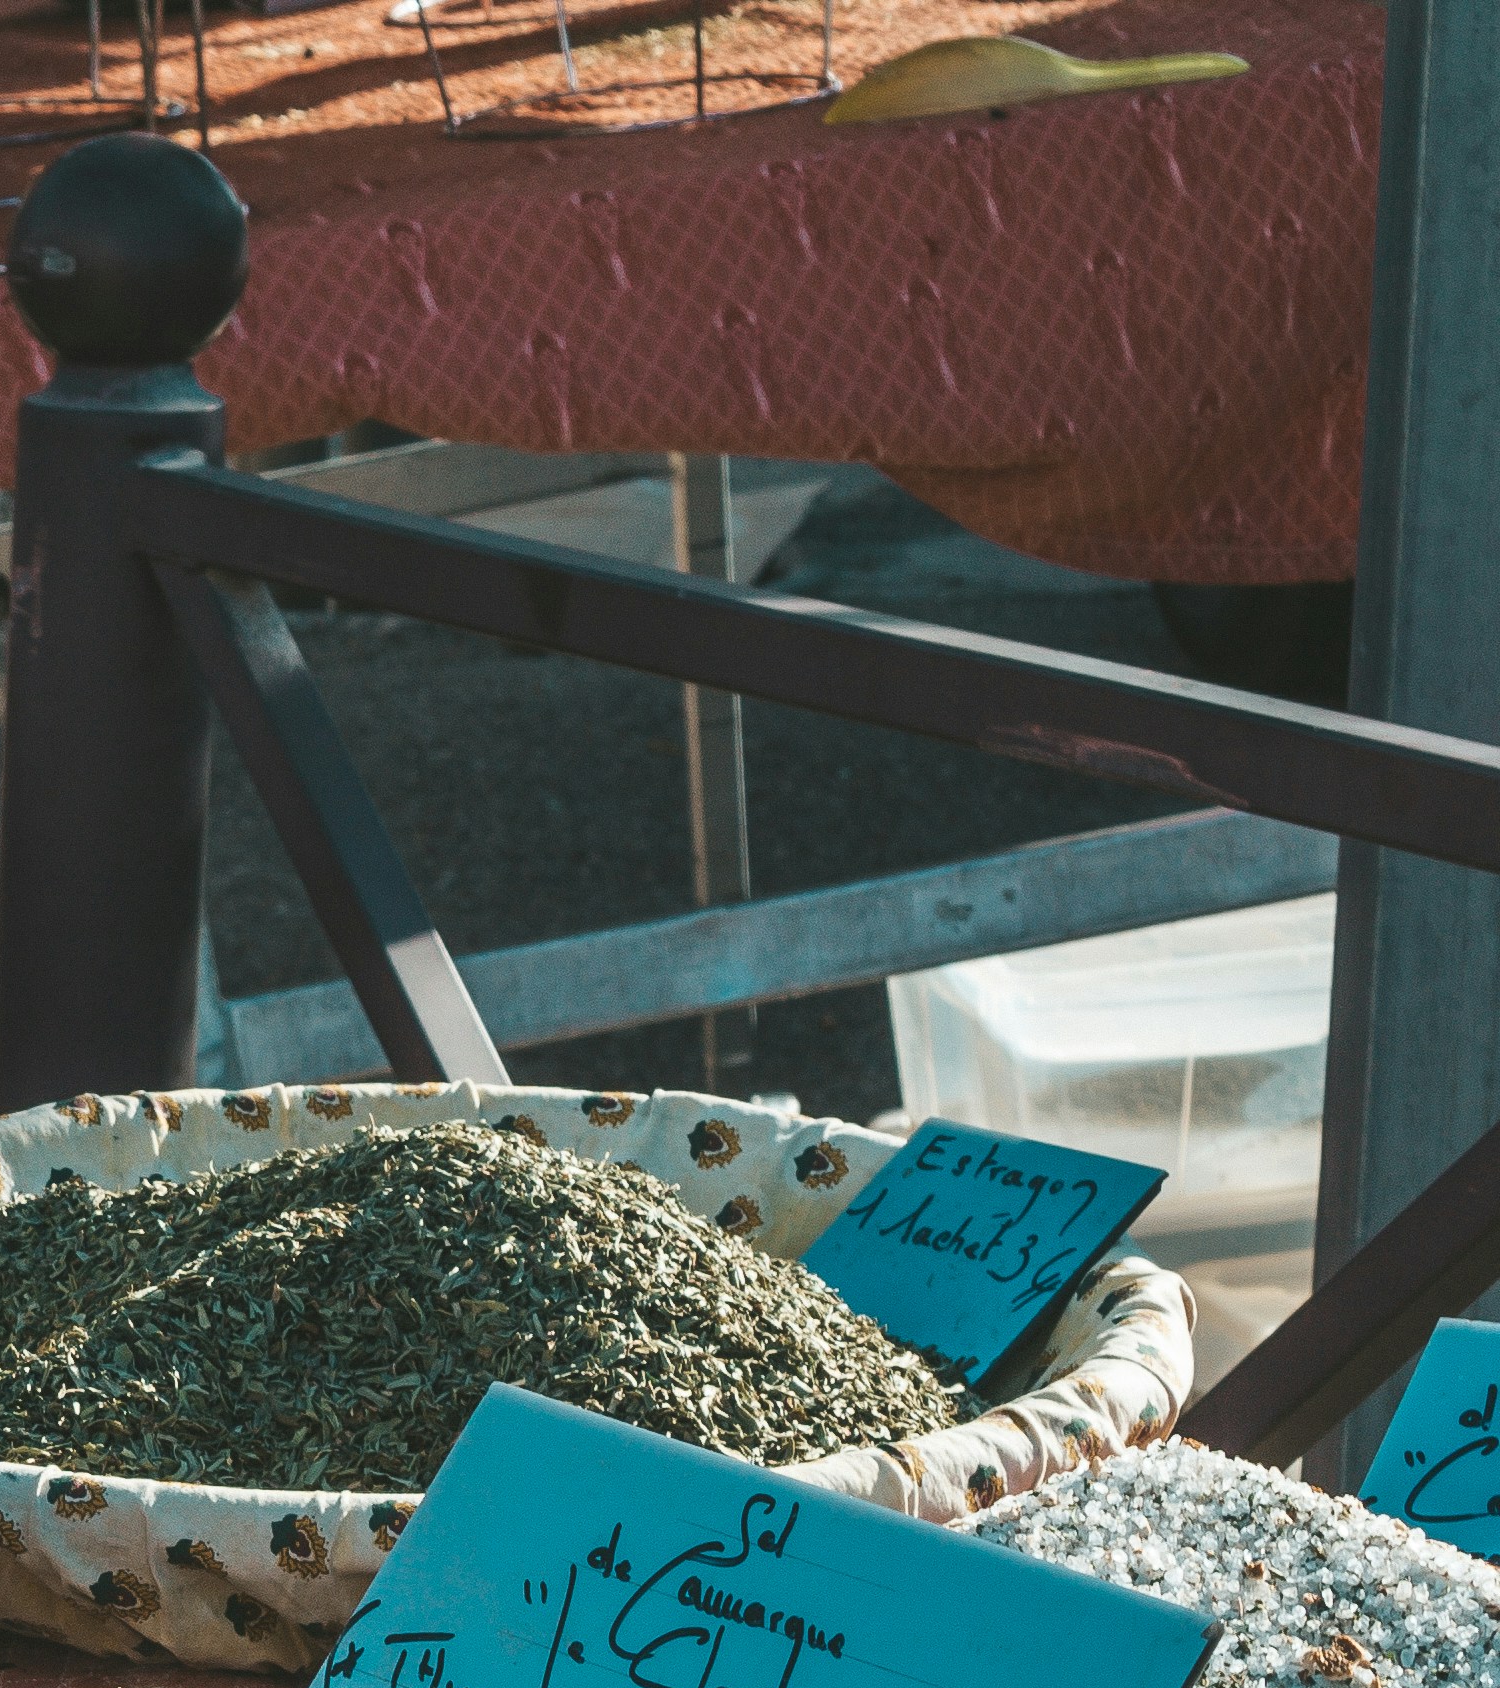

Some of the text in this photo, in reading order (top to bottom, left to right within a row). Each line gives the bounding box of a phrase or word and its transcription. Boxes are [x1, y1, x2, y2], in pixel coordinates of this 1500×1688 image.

[916, 1133, 1098, 1236] Estragon
[586, 1522, 631, 1582] de
[687, 1494, 799, 1567] Sel
